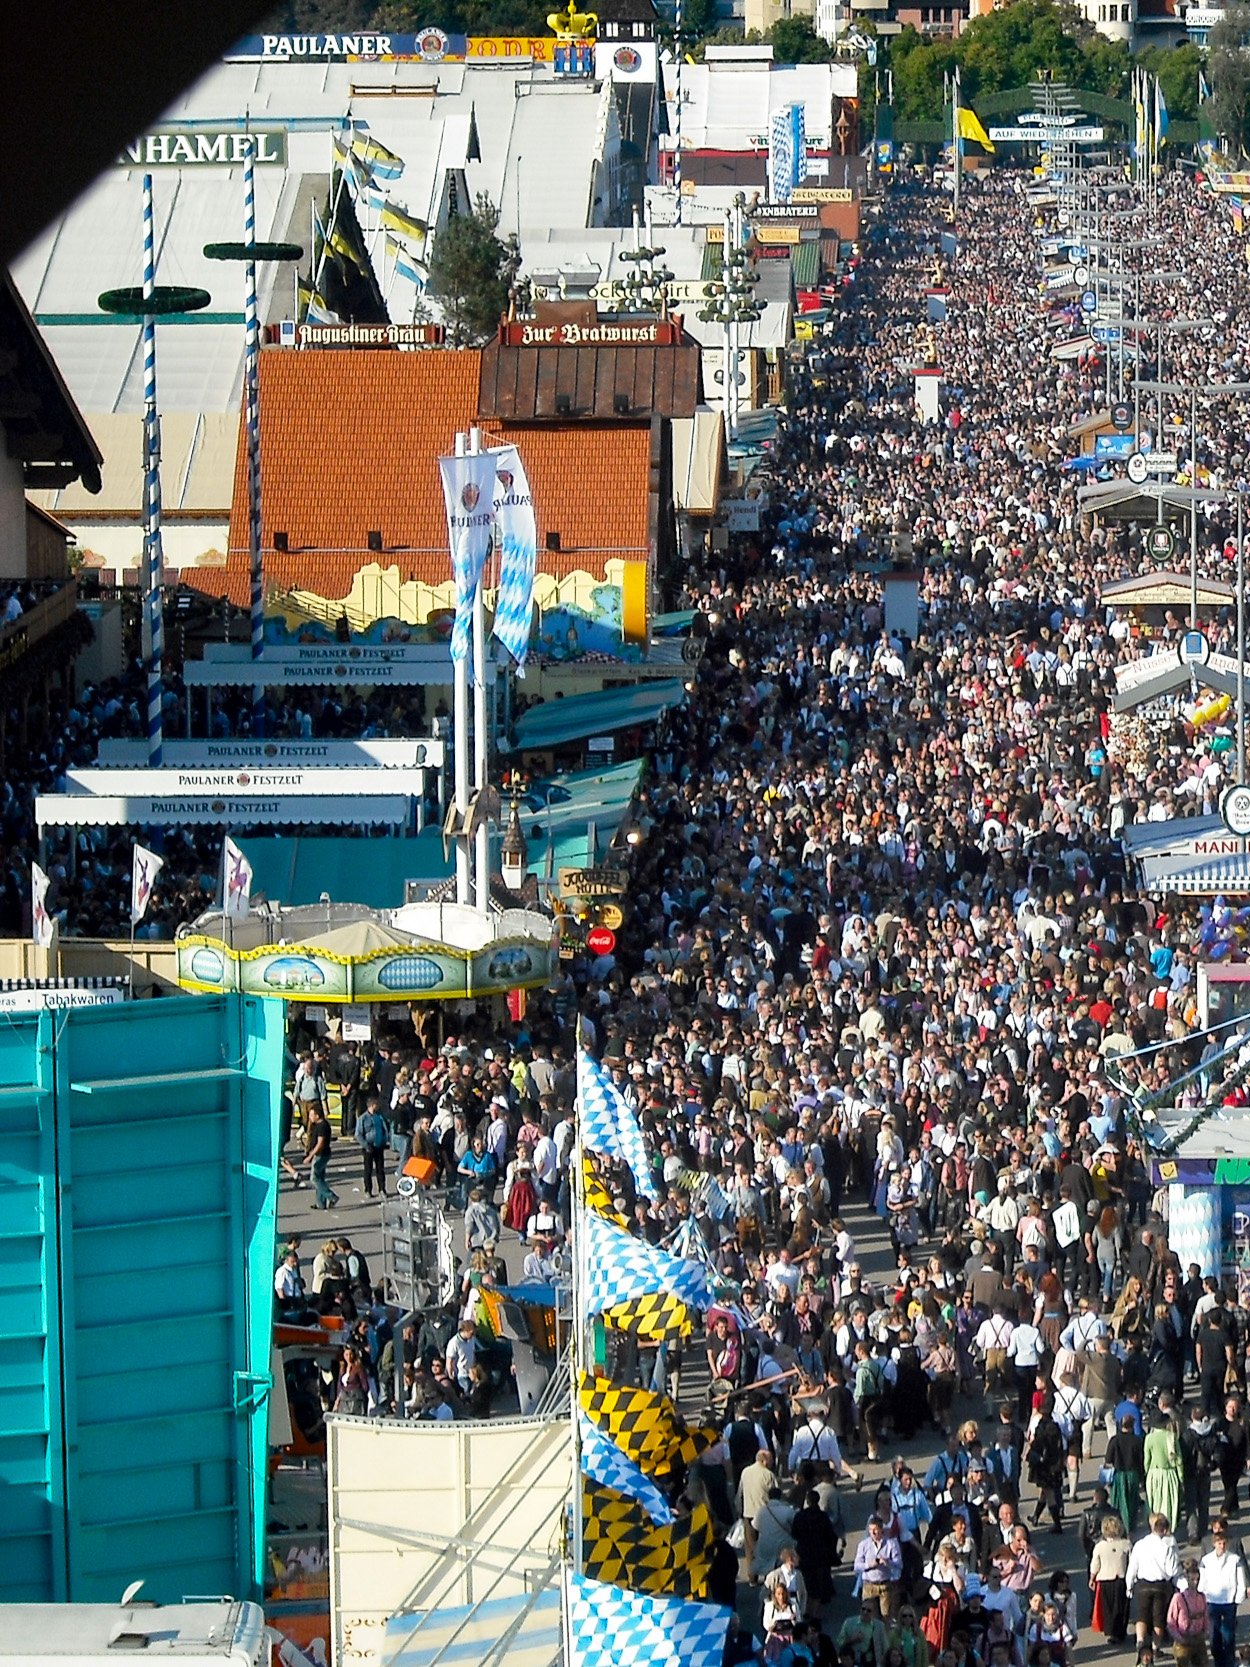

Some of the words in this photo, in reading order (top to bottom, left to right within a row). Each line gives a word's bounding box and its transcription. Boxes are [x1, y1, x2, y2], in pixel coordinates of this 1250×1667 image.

[262, 34, 393, 55] PAULANER
[521, 325, 553, 345] Zur
[560, 323, 658, 344] Bratwurst
[300, 649, 347, 658] PAULANER
[284, 666, 333, 676] PAULANER
[348, 666, 394, 676] FESTZELT
[208, 746, 262, 756] PAULANER
[279, 746, 329, 756] FESTZELT
[178, 775, 235, 785] PAULANER
[253, 775, 304, 785] FESTZELT
[151, 803, 209, 813] PAULANER
[228, 803, 281, 813] FESTZELT
[42, 993, 114, 1007] Tabakwaren
